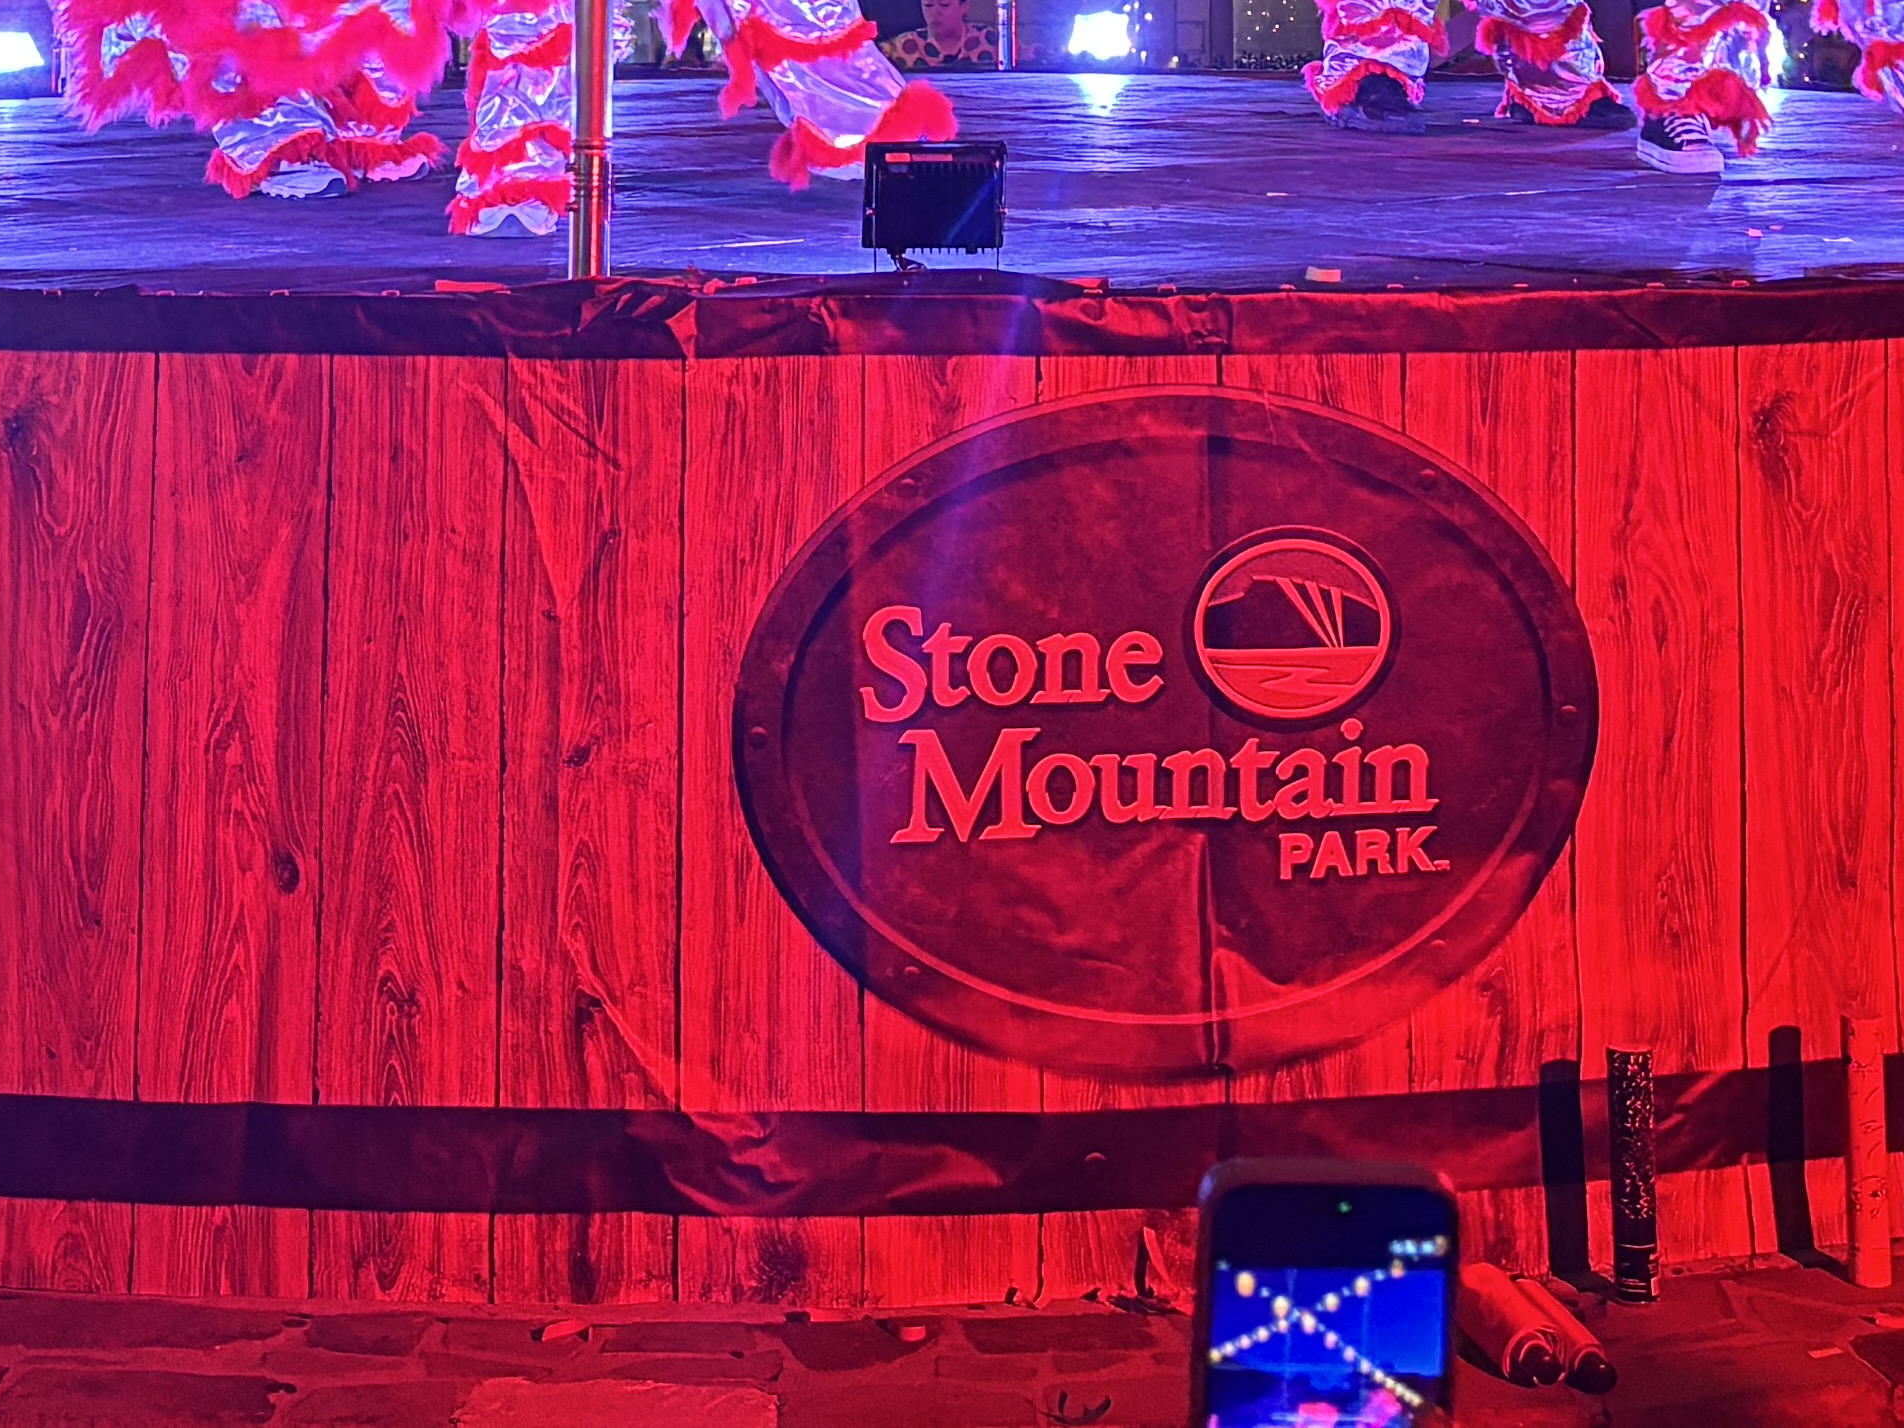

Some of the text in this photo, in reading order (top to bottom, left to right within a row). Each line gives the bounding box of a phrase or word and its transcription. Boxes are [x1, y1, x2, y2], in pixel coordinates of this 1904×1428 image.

[860, 605, 1164, 723] Stone
[890, 718, 1440, 844] Mountain
[1279, 826, 1437, 880] PARK
